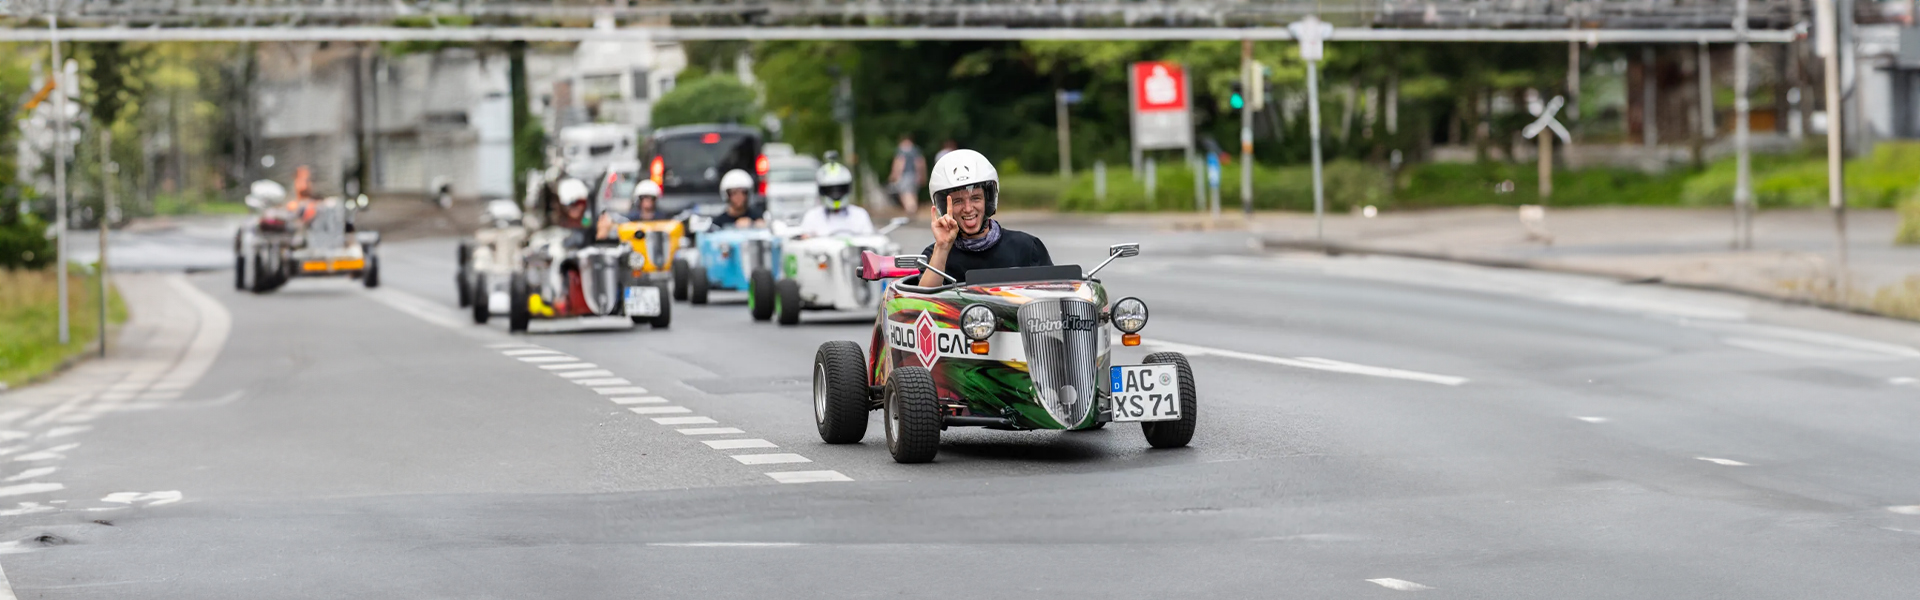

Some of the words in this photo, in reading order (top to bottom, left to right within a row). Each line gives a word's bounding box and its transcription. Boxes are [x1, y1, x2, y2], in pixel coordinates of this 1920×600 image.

[1027, 314, 1069, 333] Hotrod
[1069, 315, 1094, 330] Tour
[890, 325, 916, 349] HOLO
[1114, 382, 1120, 390] D
[1125, 369, 1154, 393] AC
[1114, 395, 1144, 418] XS
[1149, 393, 1178, 416] 71
